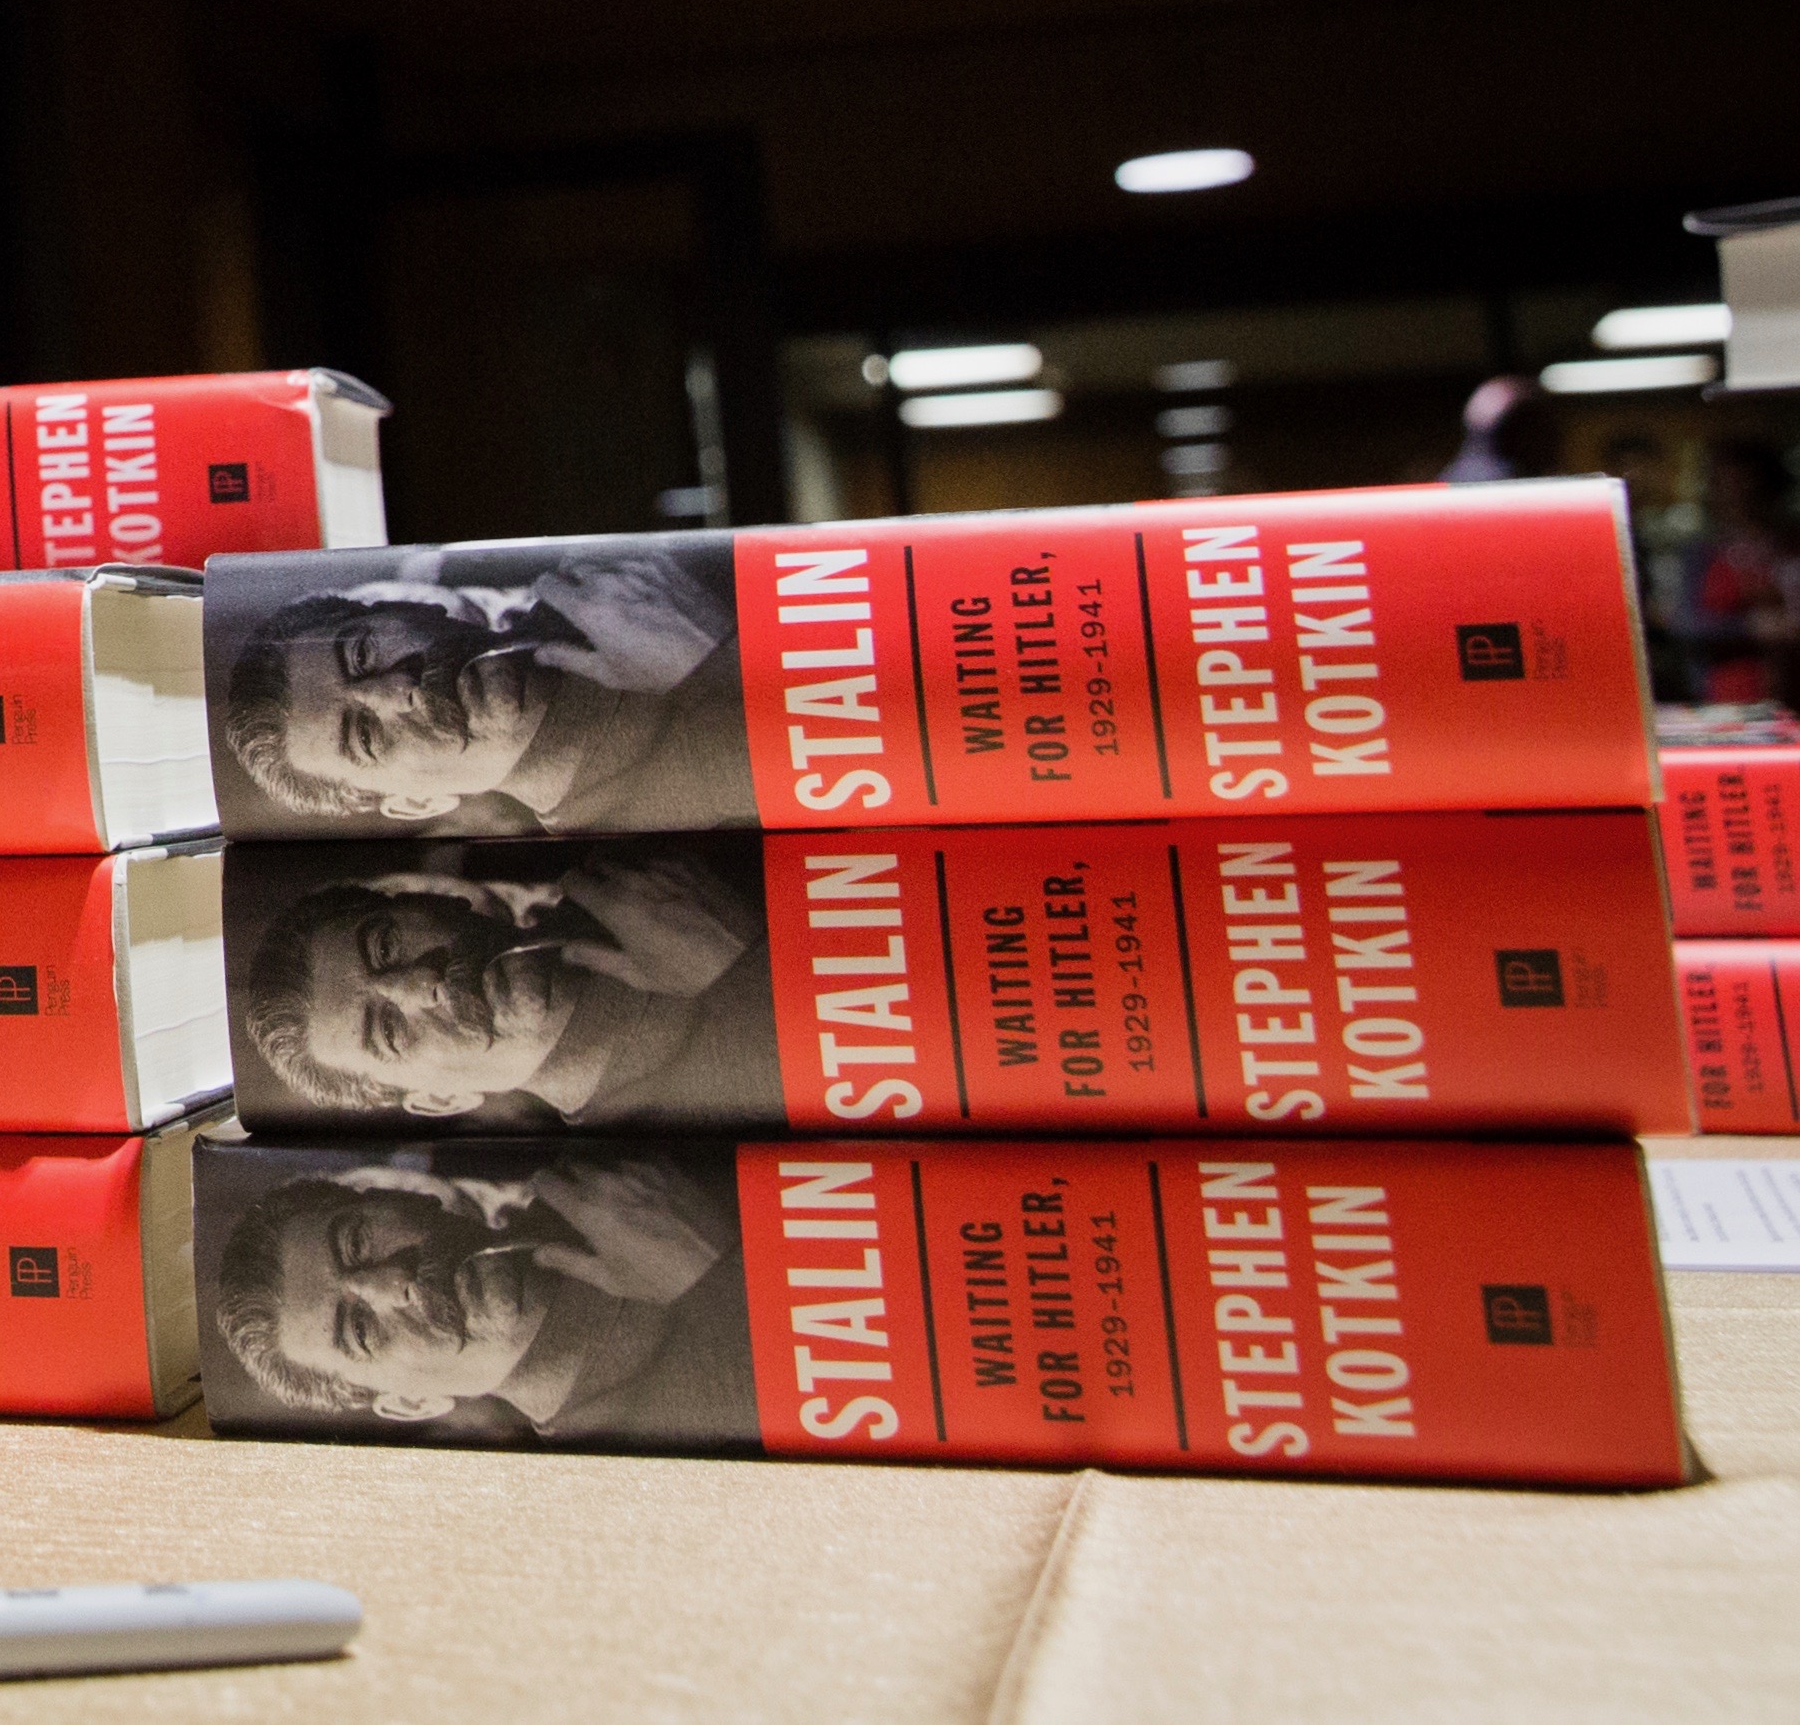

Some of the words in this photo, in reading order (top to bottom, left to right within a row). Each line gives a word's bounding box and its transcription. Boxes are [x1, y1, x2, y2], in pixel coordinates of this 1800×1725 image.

[774, 548, 892, 811] STALIN
[951, 597, 1004, 754] WAITING
[1011, 553, 1063, 696] HITLER,
[1078, 581, 1119, 754] 1929-1941
[1182, 524, 1288, 800] STEPHEN
[1286, 539, 1392, 777] KOTKIN
[1024, 714, 1070, 781] FOR
[1678, 790, 1719, 891] WAITING
[1731, 866, 1765, 912] FOR
[806, 855, 923, 1118] STALIN
[982, 905, 1037, 1065] WAITING
[1043, 861, 1095, 1007] HITLER,
[1109, 889, 1154, 1069] 1929-1941
[1220, 842, 1324, 1118] STEPHEN
[1325, 862, 1430, 1099] KOTKIN
[1058, 1029, 1106, 1097] FOR
[1699, 1066, 1734, 1110] FOR
[780, 1163, 899, 1439] STALIN
[960, 1222, 1017, 1387] WAITING
[1021, 1177, 1075, 1329] HITLER,
[1090, 1210, 1134, 1396] 1929-1941
[1200, 1164, 1310, 1456] STEPHEN
[1307, 1187, 1416, 1437] KOTKIN
[1037, 1350, 1085, 1423] FOR
